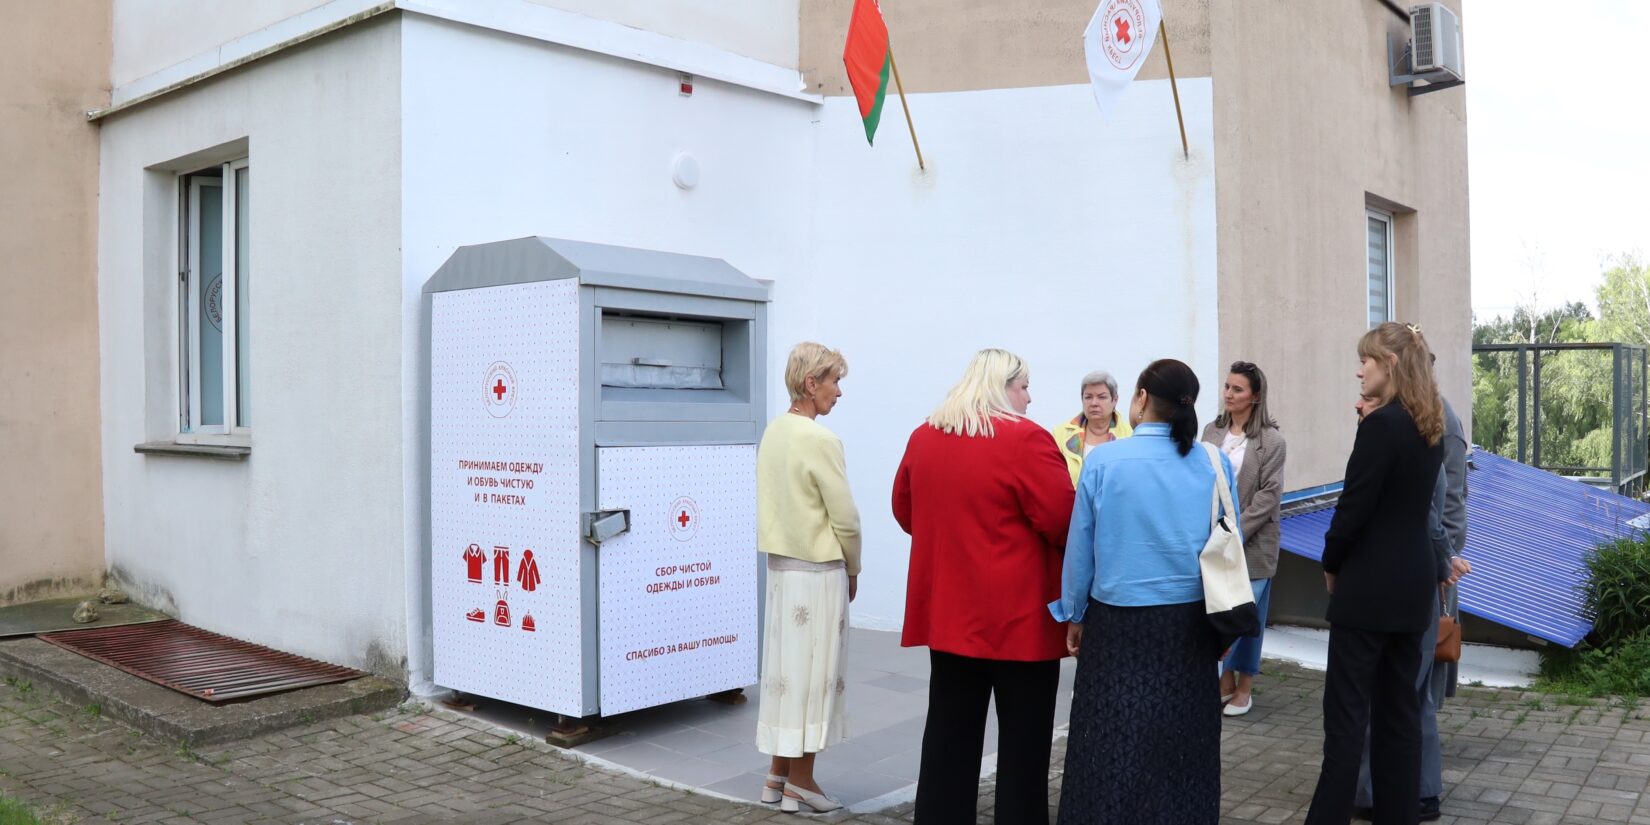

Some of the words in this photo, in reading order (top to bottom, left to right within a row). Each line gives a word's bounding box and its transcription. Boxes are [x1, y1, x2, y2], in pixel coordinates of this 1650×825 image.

[459, 460, 507, 472] ПРИНИМАЕМ
[509, 462, 544, 475] ОДЕЖДУ
[467, 476, 473, 486] И
[474, 477, 498, 488] ОБУВЬ
[500, 478, 534, 489] ЧИСТУЮ
[474, 493, 480, 502] И
[483, 493, 488, 503] В
[491, 494, 526, 506] ПАКЕТАХ
[655, 565, 677, 577] СБОР
[679, 560, 712, 574] ЧИСТОЙ
[646, 580, 685, 595] ОДЕЖДЫ
[686, 579, 692, 588] И
[694, 575, 720, 587] ОБУВИ
[626, 646, 665, 661] СПАСИБО
[667, 645, 677, 654] ЗА
[678, 640, 700, 652] ВАШУ
[702, 633, 739, 647] ПОМОЩЬ!
